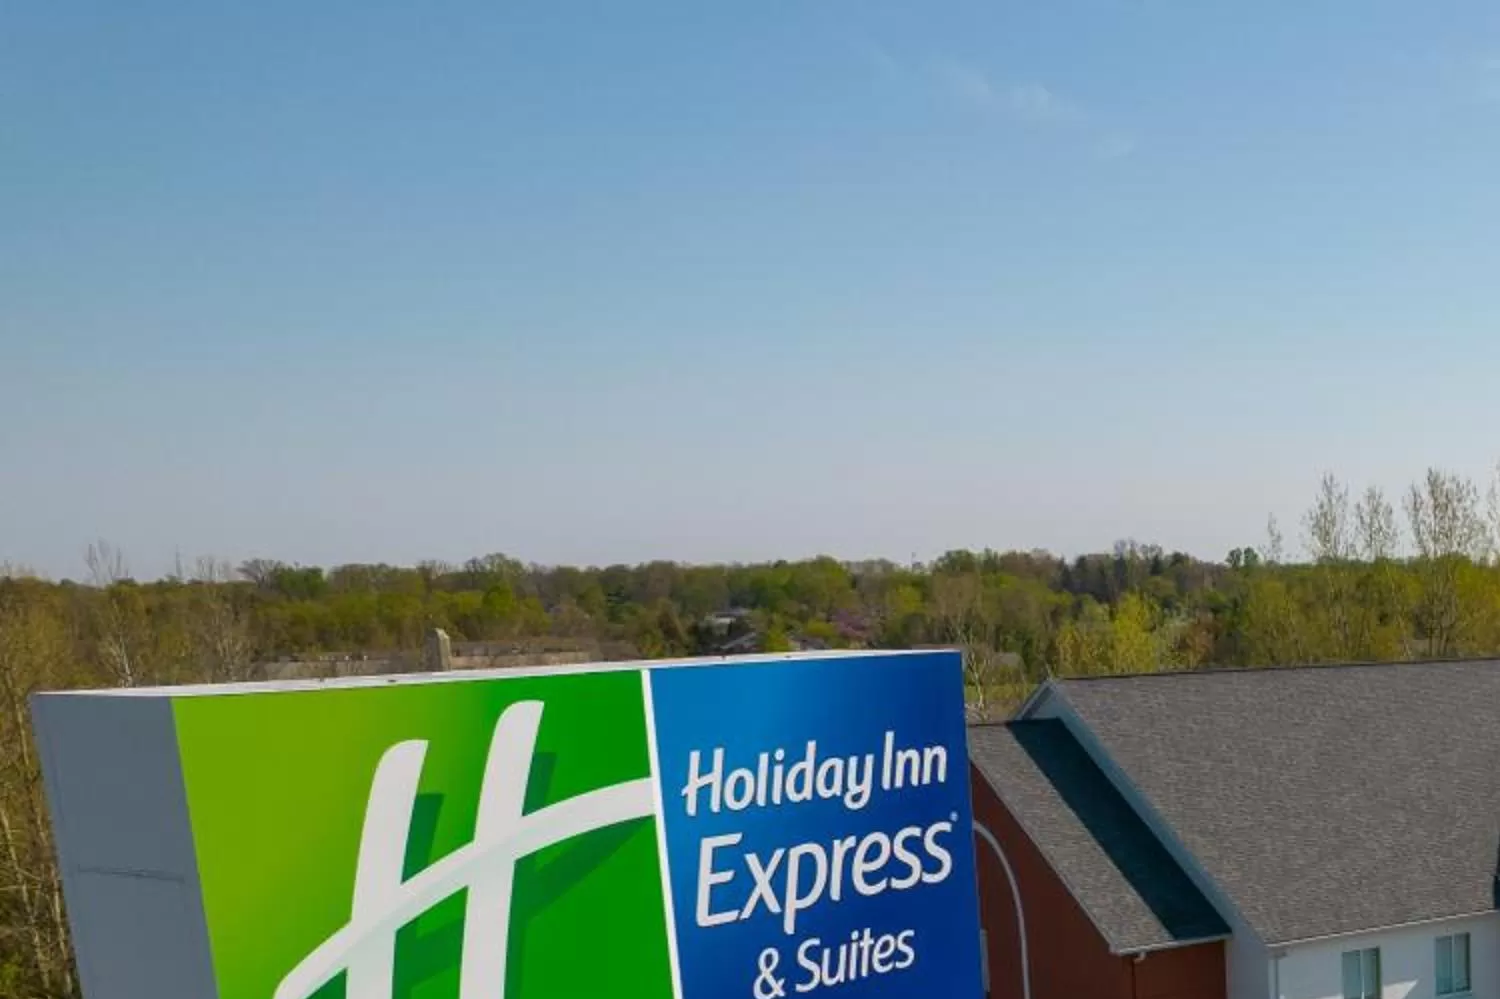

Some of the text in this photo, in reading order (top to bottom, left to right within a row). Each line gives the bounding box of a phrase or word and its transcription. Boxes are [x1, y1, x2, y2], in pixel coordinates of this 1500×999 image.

[681, 730, 947, 817] Holiday Inn
[695, 820, 953, 935] Express
[794, 928, 916, 993] Suites
